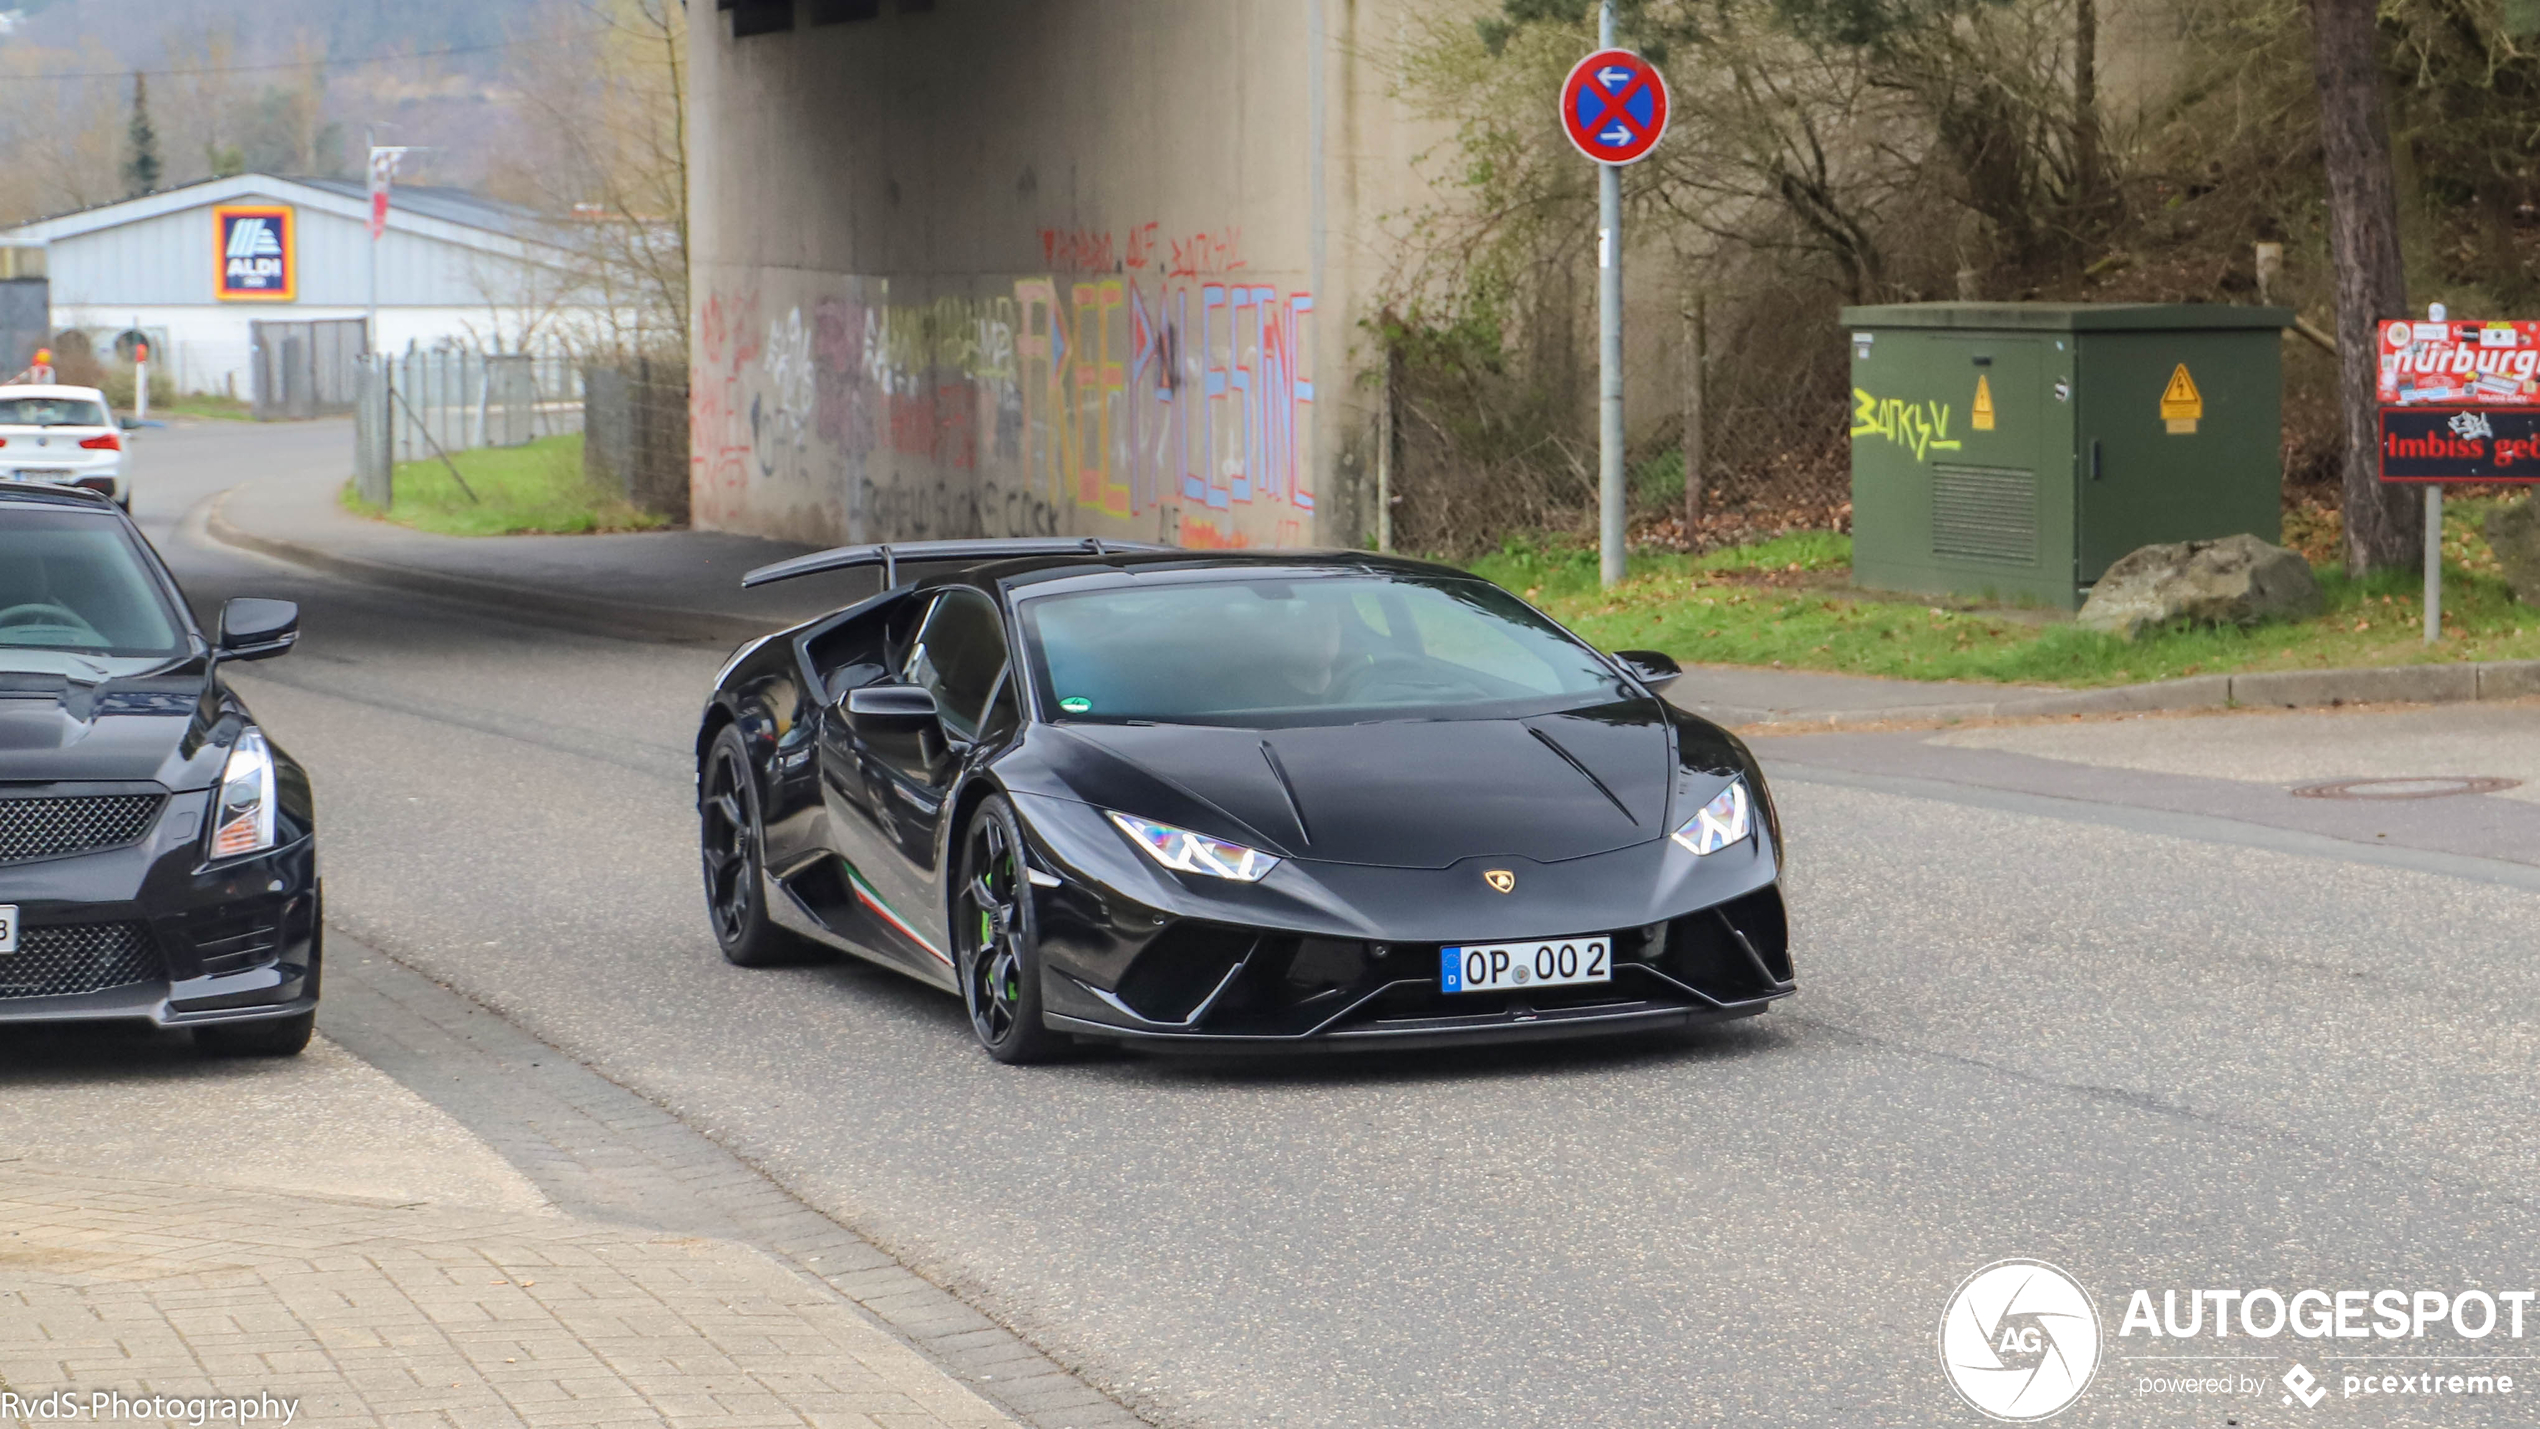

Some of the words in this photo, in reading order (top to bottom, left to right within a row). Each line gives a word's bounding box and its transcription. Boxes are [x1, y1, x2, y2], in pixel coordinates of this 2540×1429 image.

[226, 258, 282, 276] ALDI
[2394, 341, 2540, 381] nürburg
[1014, 276, 1130, 520] FREE
[1129, 276, 1315, 513] PALESTINE
[2388, 430, 2485, 457] Imbiss
[1447, 974, 1457, 985] D
[1467, 951, 1509, 984] OP
